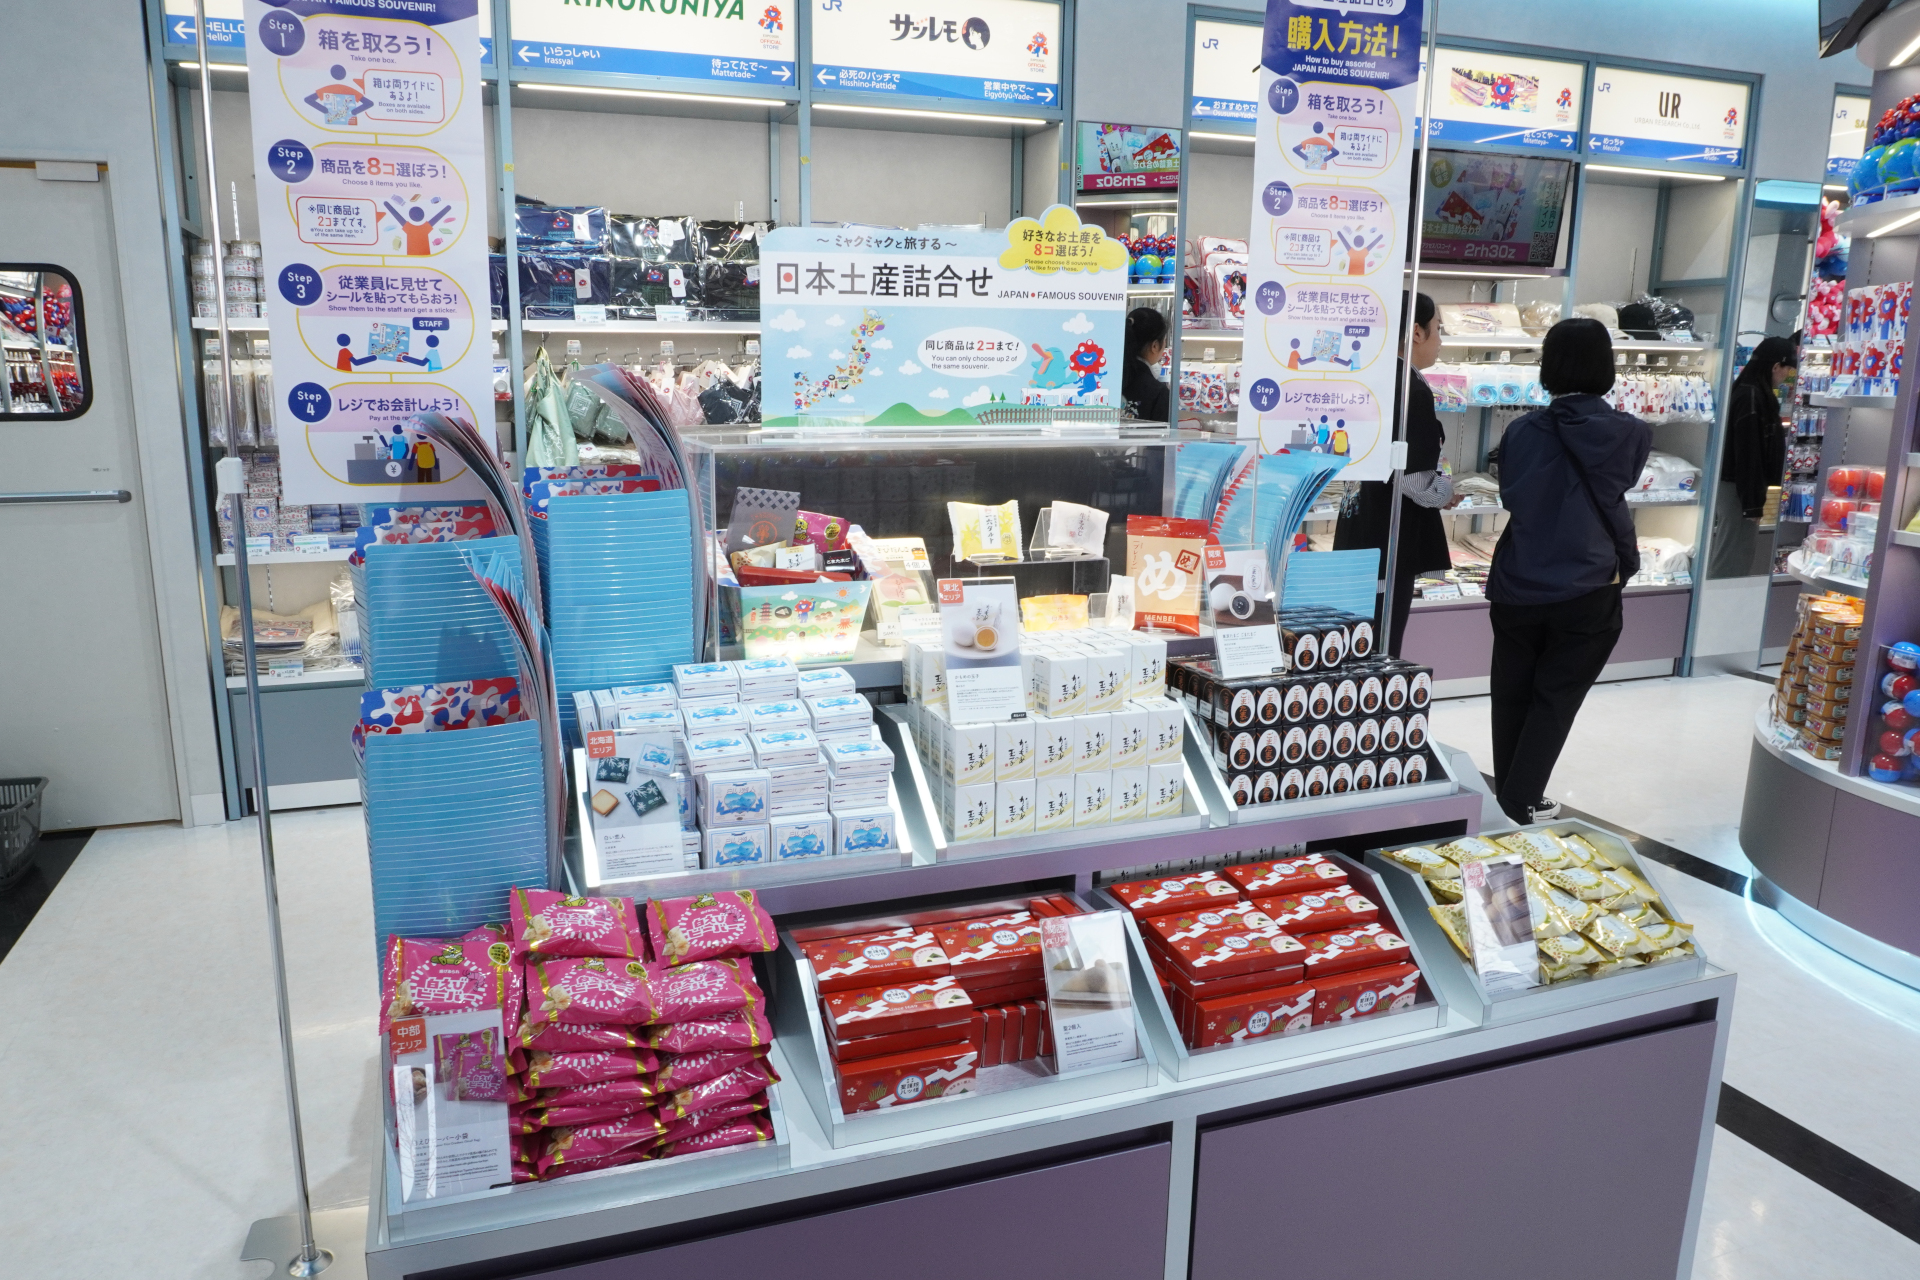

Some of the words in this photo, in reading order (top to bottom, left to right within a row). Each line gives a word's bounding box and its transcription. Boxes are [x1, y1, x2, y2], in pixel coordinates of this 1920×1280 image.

[269, 19, 295, 33] Step
[280, 33, 285, 48] 1
[318, 29, 432, 55] 箱を取ろう！
[1287, 15, 1399, 58] 購入方法！
[1202, 38, 1218, 50] JR
[544, 46, 600, 59] いらっしゃい
[544, 56, 574, 66] Irassyai
[1306, 55, 1321, 64] How
[1322, 56, 1329, 65] to
[1331, 57, 1344, 67] buy
[1345, 59, 1376, 68] assorted
[839, 68, 900, 83] 必死のパッチで
[1292, 64, 1316, 73] JAPAN
[1318, 66, 1348, 76] FAMOUS
[1349, 68, 1390, 79] SOUVENIR!
[373, 77, 435, 91] 箱は両サイドに
[840, 79, 896, 90] Hisshino-Pattide
[1275, 85, 1293, 96] Step
[1598, 83, 1611, 92] JR
[390, 91, 418, 102] あるよ！
[1282, 96, 1285, 108] 1
[1308, 93, 1384, 114] 箱を取ろう！
[1659, 91, 1681, 119] UR
[1836, 110, 1847, 119] JR
[1634, 117, 1653, 125] URBAN
[1654, 119, 1682, 128] RESEARCH
[1603, 137, 1624, 146] めっちゃ
[1603, 144, 1620, 152] Meccha
[278, 148, 303, 160] Step
[286, 160, 296, 175] 2
[321, 157, 446, 178] 商品を8コ選ぼう！
[1269, 188, 1287, 198] Step
[1274, 198, 1280, 210] 2
[1298, 195, 1383, 212] 商品を8コ選ぼう！
[318, 216, 366, 229] 2コまでです。
[1023, 229, 1101, 244] 好きなお土産を
[1034, 244, 1094, 257] 8コ選ぼう！
[1464, 243, 1516, 258] 2rh30z
[288, 272, 313, 284] Step
[338, 275, 442, 292] 従業員に見せて
[776, 261, 993, 297] 日本土産詰合せ
[296, 284, 306, 299] 3
[326, 291, 458, 304] シールを貼ってもらおう！
[998, 291, 1029, 299] JAPAN
[1037, 291, 1076, 300] FAMOUS
[1078, 292, 1124, 301] SOUVENIR
[1262, 288, 1280, 298] Step
[1297, 290, 1370, 305] 従業員に見せて
[1267, 298, 1273, 310] 3
[1287, 303, 1378, 316] シールを貼ってもらおう！
[297, 391, 322, 401] Step
[1256, 385, 1274, 395] Step
[338, 398, 459, 412] レジでお会計しよう！
[1261, 395, 1268, 406] 4
[1285, 392, 1370, 405] レジでお会計しよう！
[306, 403, 315, 416] 4
[1208, 550, 1222, 558] 関東
[906, 561, 929, 569] 4個入
[1138, 551, 1187, 600] め
[1144, 614, 1176, 622] MENBEI
[590, 736, 613, 745] 北海道
[592, 746, 612, 754] エリア
[425, 977, 469, 990] 白えび
[416, 987, 483, 1003] ビーバー
[397, 1025, 420, 1038] 中部
[398, 1040, 422, 1050] エリア
